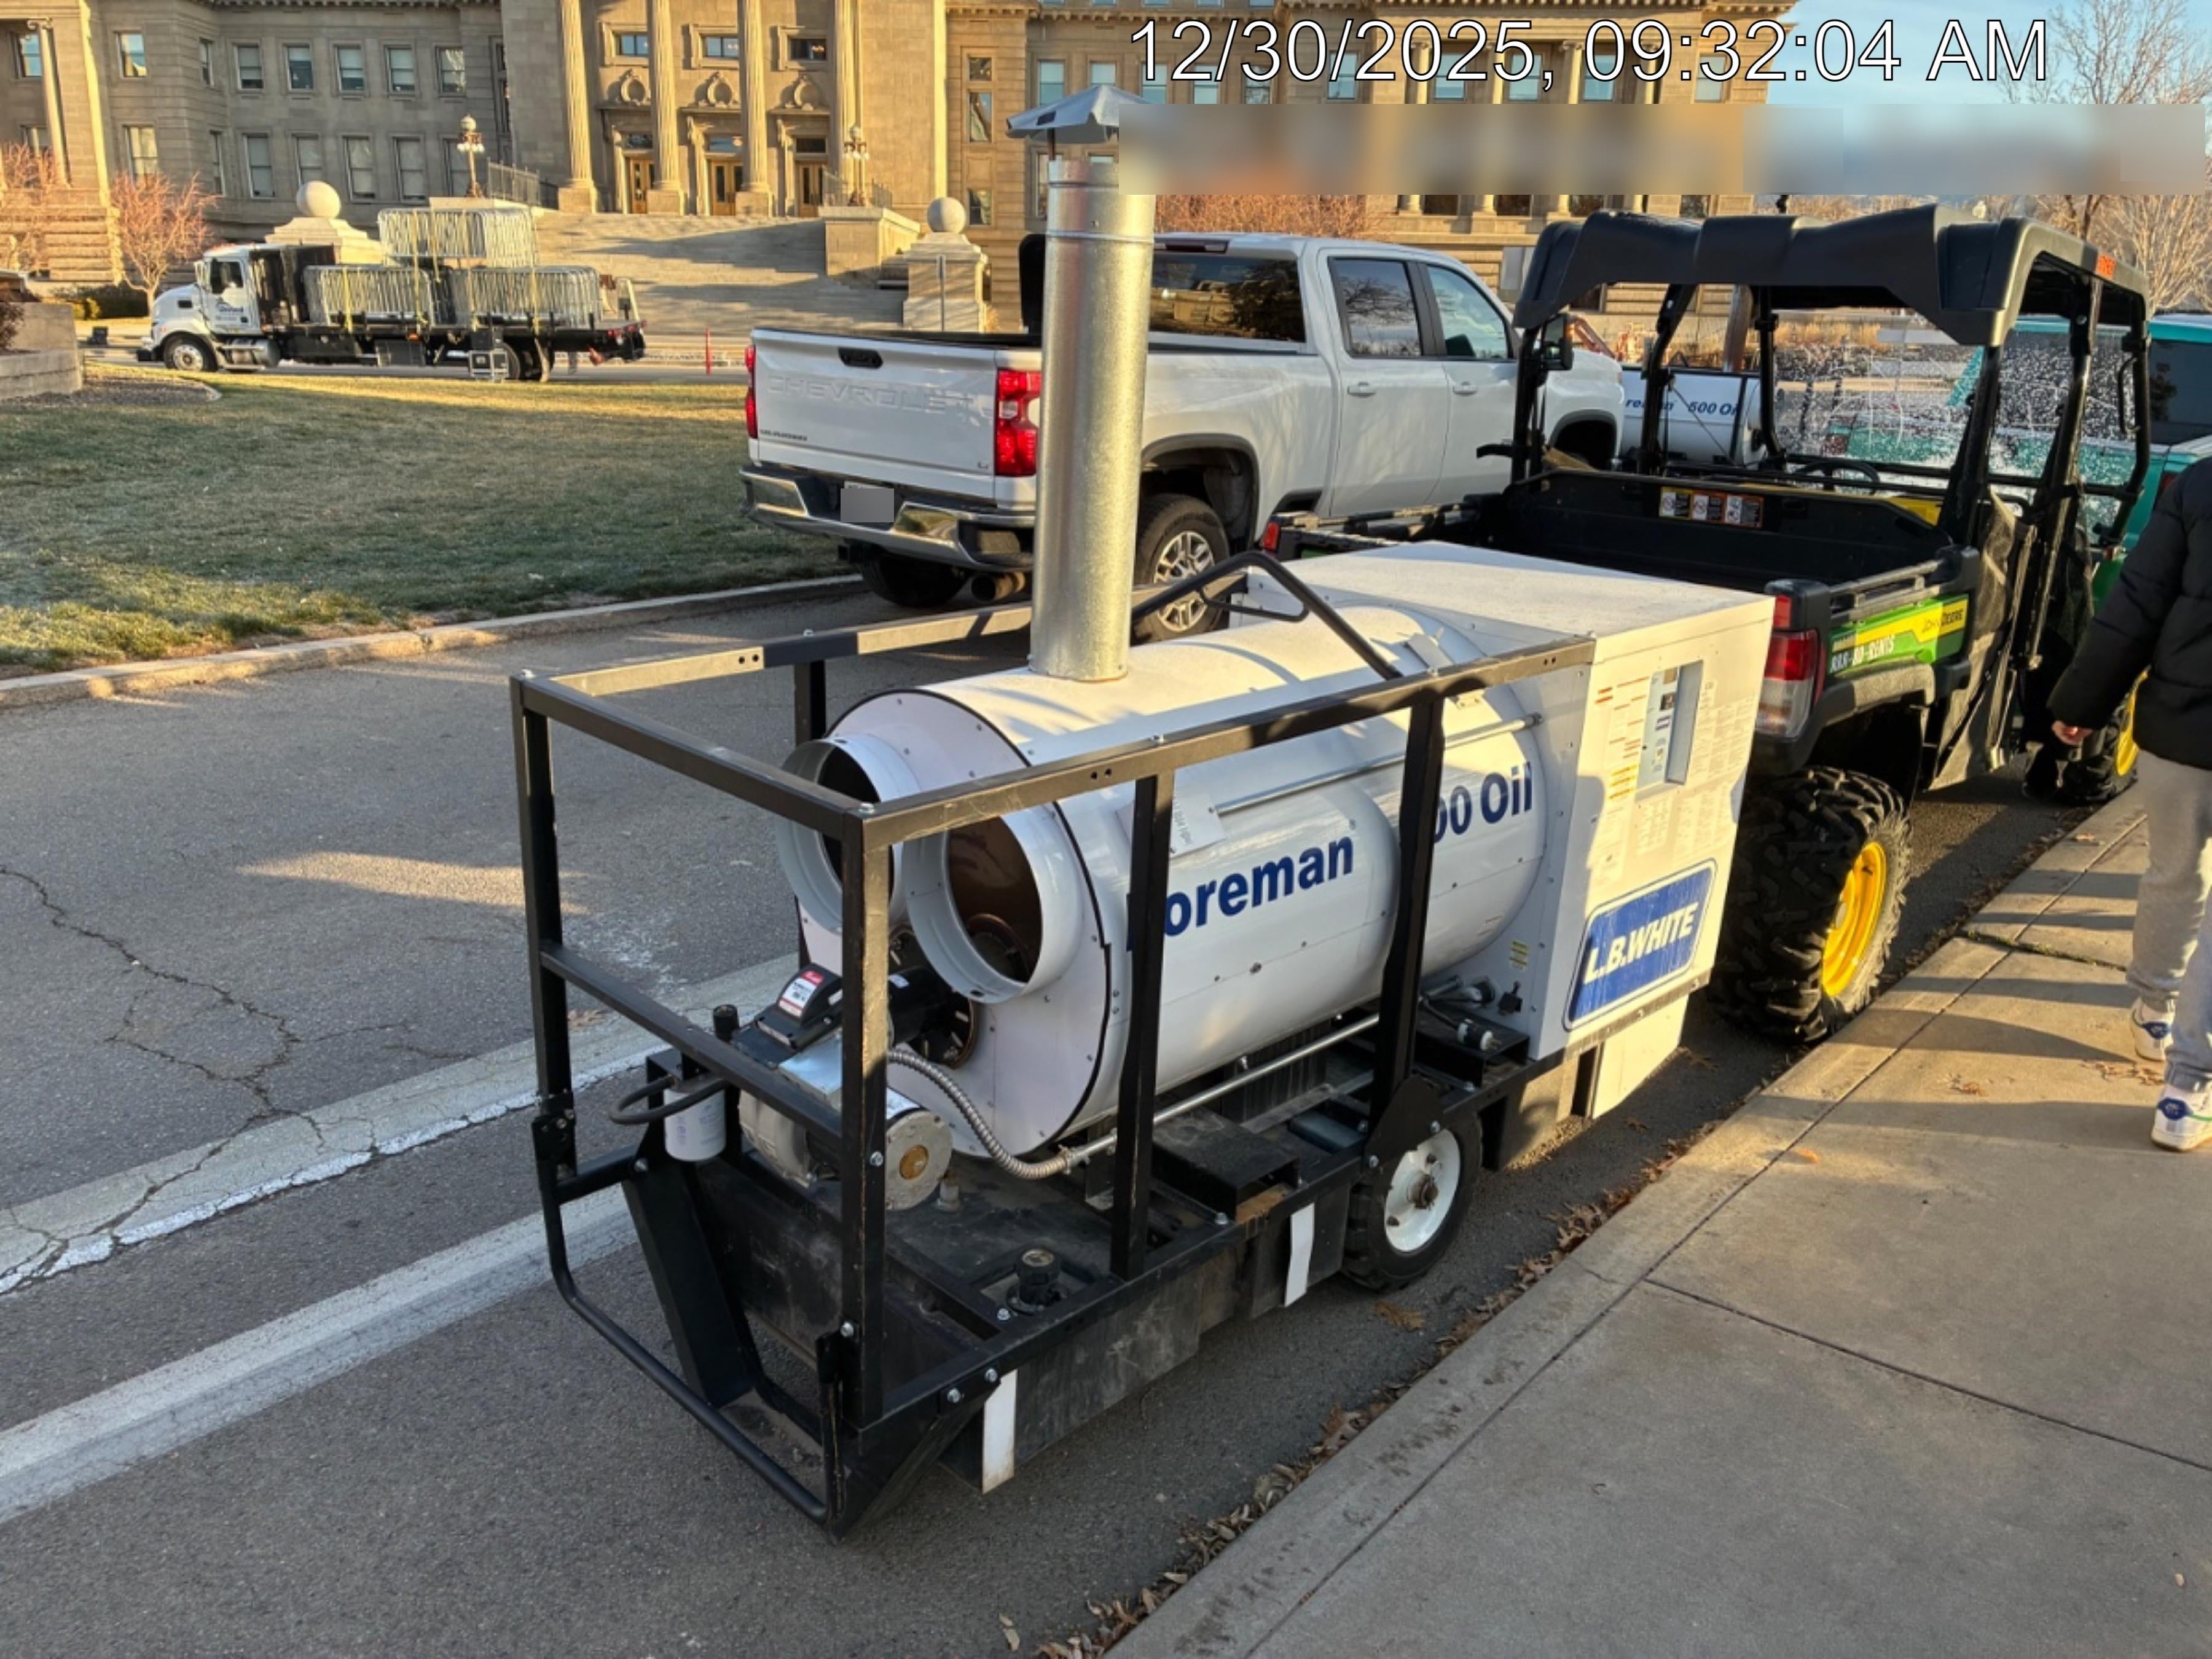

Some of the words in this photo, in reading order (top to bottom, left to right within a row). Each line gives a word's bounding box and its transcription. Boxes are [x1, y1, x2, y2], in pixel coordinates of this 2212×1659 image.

[767, 374, 975, 423] CHEVROLET
[1688, 401, 1717, 414] 500
[1126, 836, 1353, 952] oreman
[1433, 785, 1472, 843] 00
[1481, 761, 1532, 824] Oil
